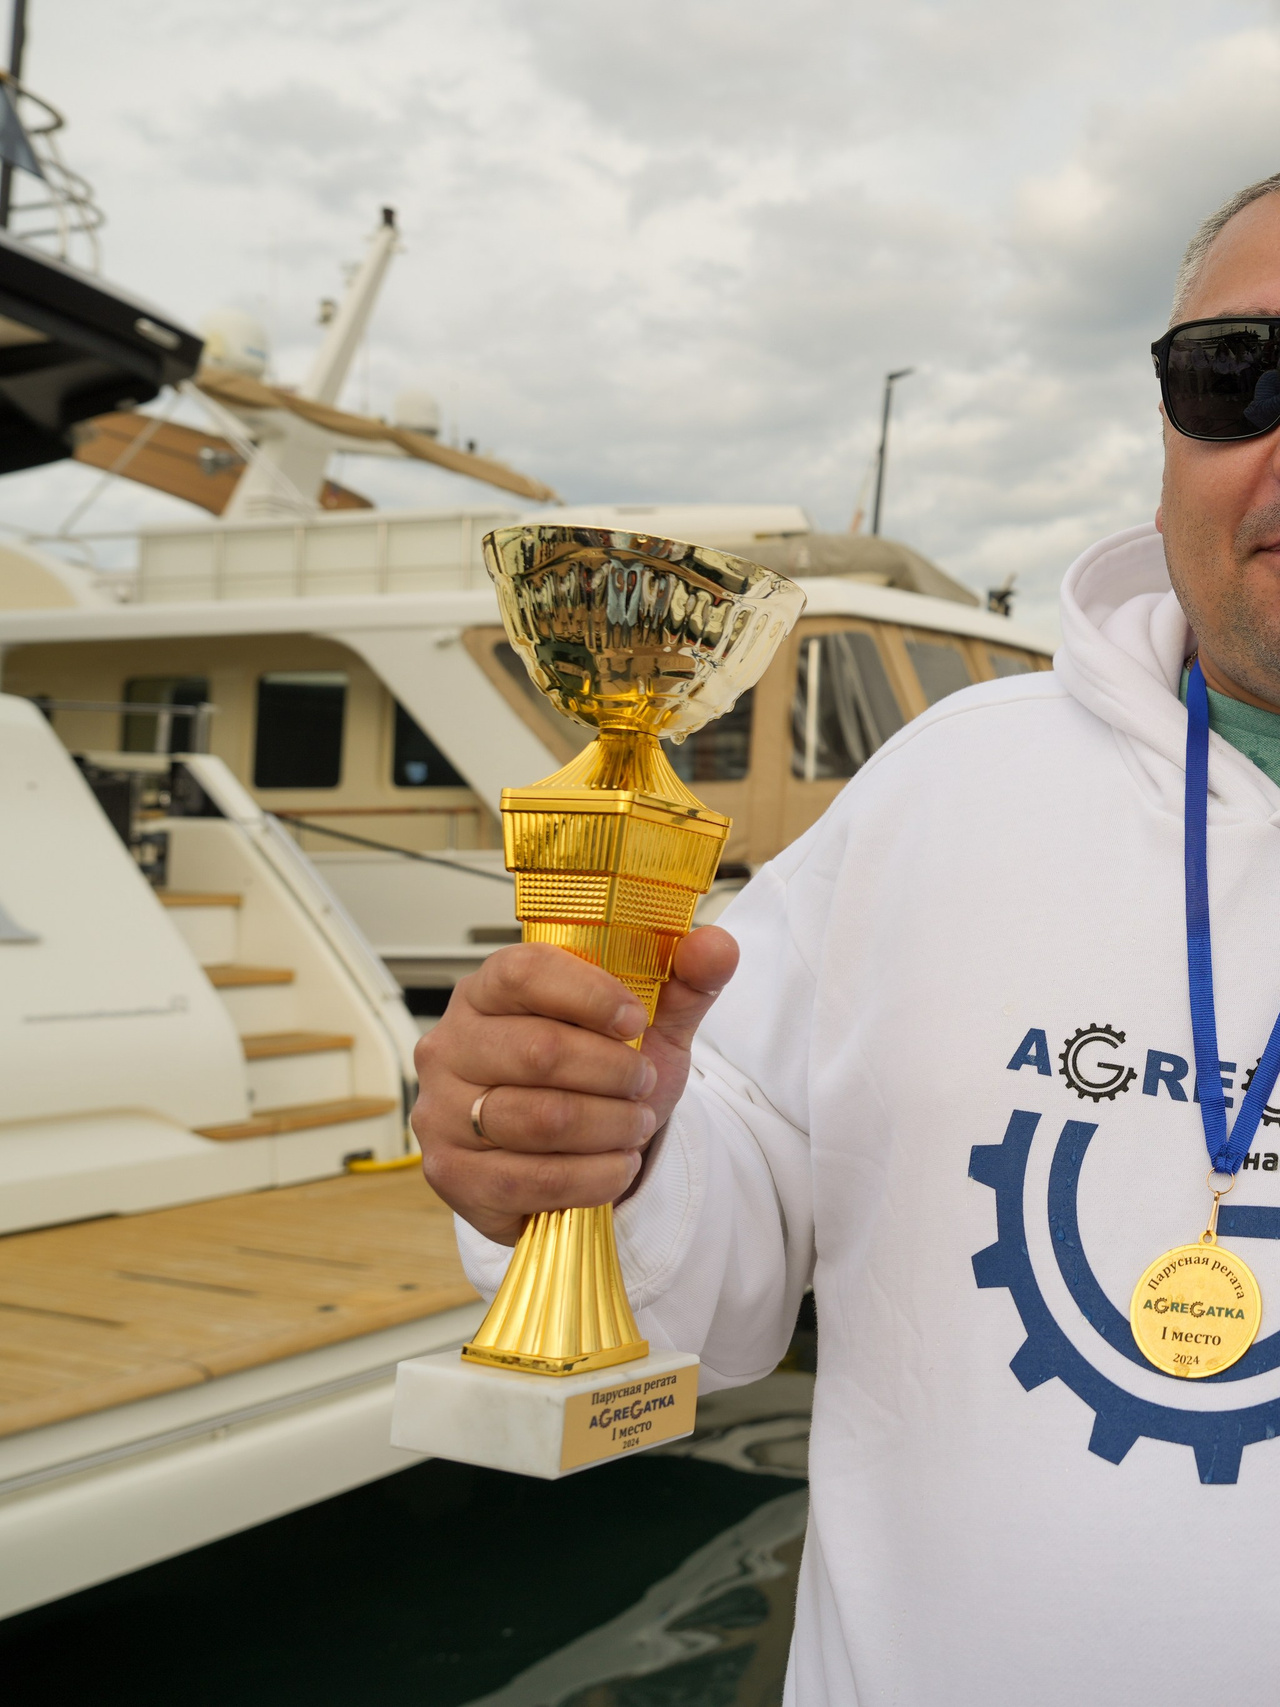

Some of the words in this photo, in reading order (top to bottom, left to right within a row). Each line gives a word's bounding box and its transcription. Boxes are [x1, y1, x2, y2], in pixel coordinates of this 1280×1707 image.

[1147, 1256, 1210, 1291] Парусная
[1211, 1260, 1245, 1299] регата
[1143, 1297, 1245, 1320] AGREGATKA
[1171, 1331, 1222, 1346] место
[1172, 1352, 1200, 1365] 2024
[591, 1384, 642, 1406] Парусная
[644, 1375, 677, 1395] регата
[589, 1394, 675, 1429] AGREGATKA
[619, 1420, 652, 1438] место
[622, 1437, 640, 1449] 2024
